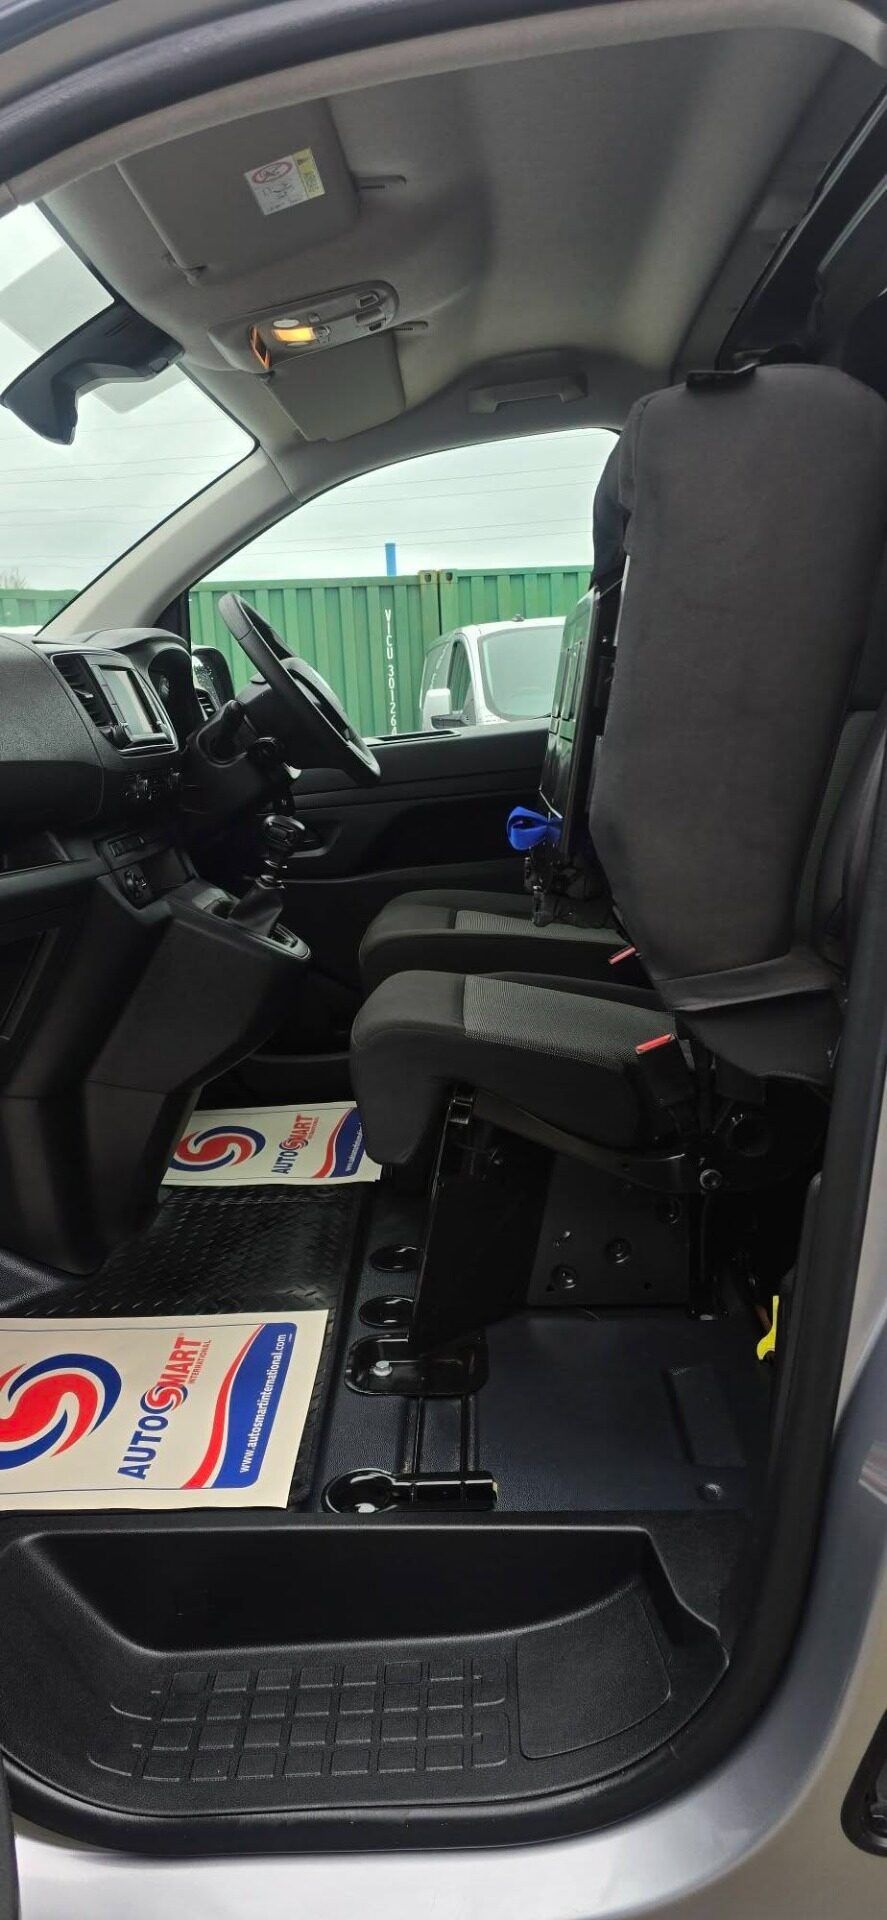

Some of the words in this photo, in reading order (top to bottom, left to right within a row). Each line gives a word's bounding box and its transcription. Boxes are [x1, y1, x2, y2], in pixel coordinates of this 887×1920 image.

[384, 609, 394, 660] VICU
[117, 1336, 202, 1480] AUTOSMART
[188, 1338, 213, 1385] INTERNATIONAL
[240, 1334, 287, 1473] www.autosmartinternational.com
